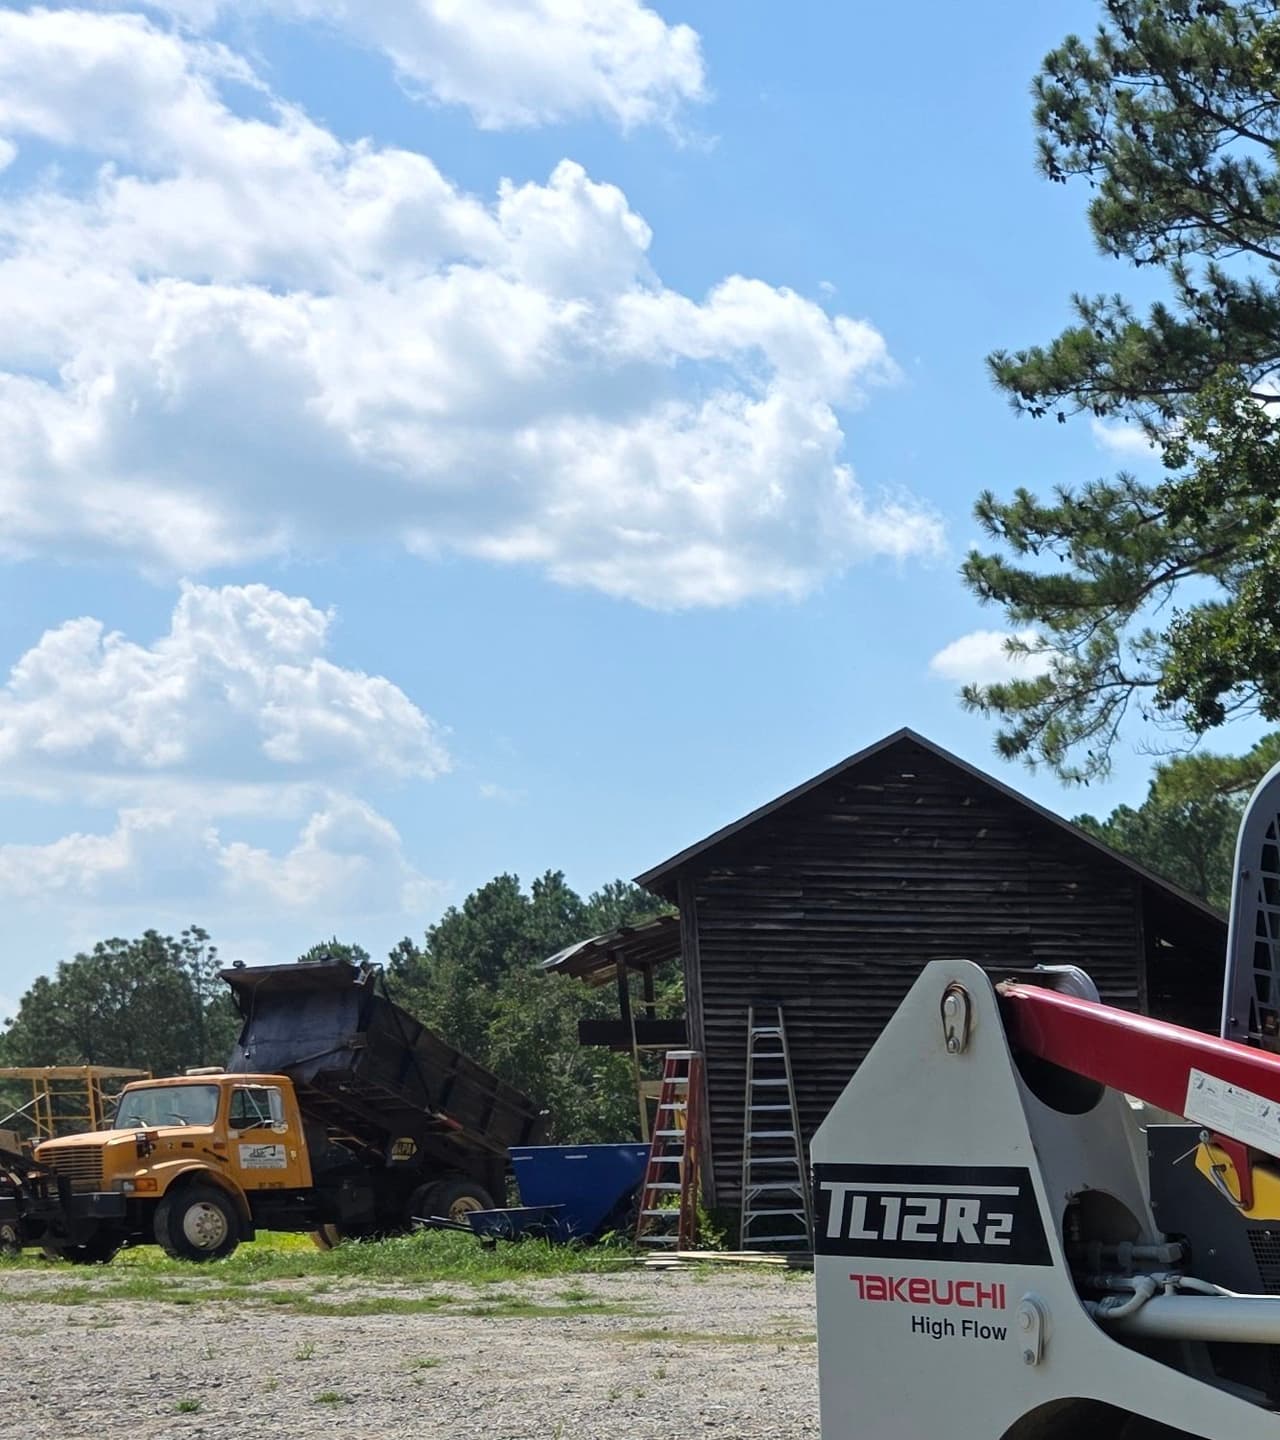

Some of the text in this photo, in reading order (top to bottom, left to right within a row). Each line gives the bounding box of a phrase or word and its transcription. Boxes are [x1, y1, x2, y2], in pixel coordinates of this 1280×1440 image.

[820, 1181, 1020, 1246] TL12R2
[849, 1274, 1006, 1310] TAKEUCHI
[911, 1315, 1008, 1342] High Flow
